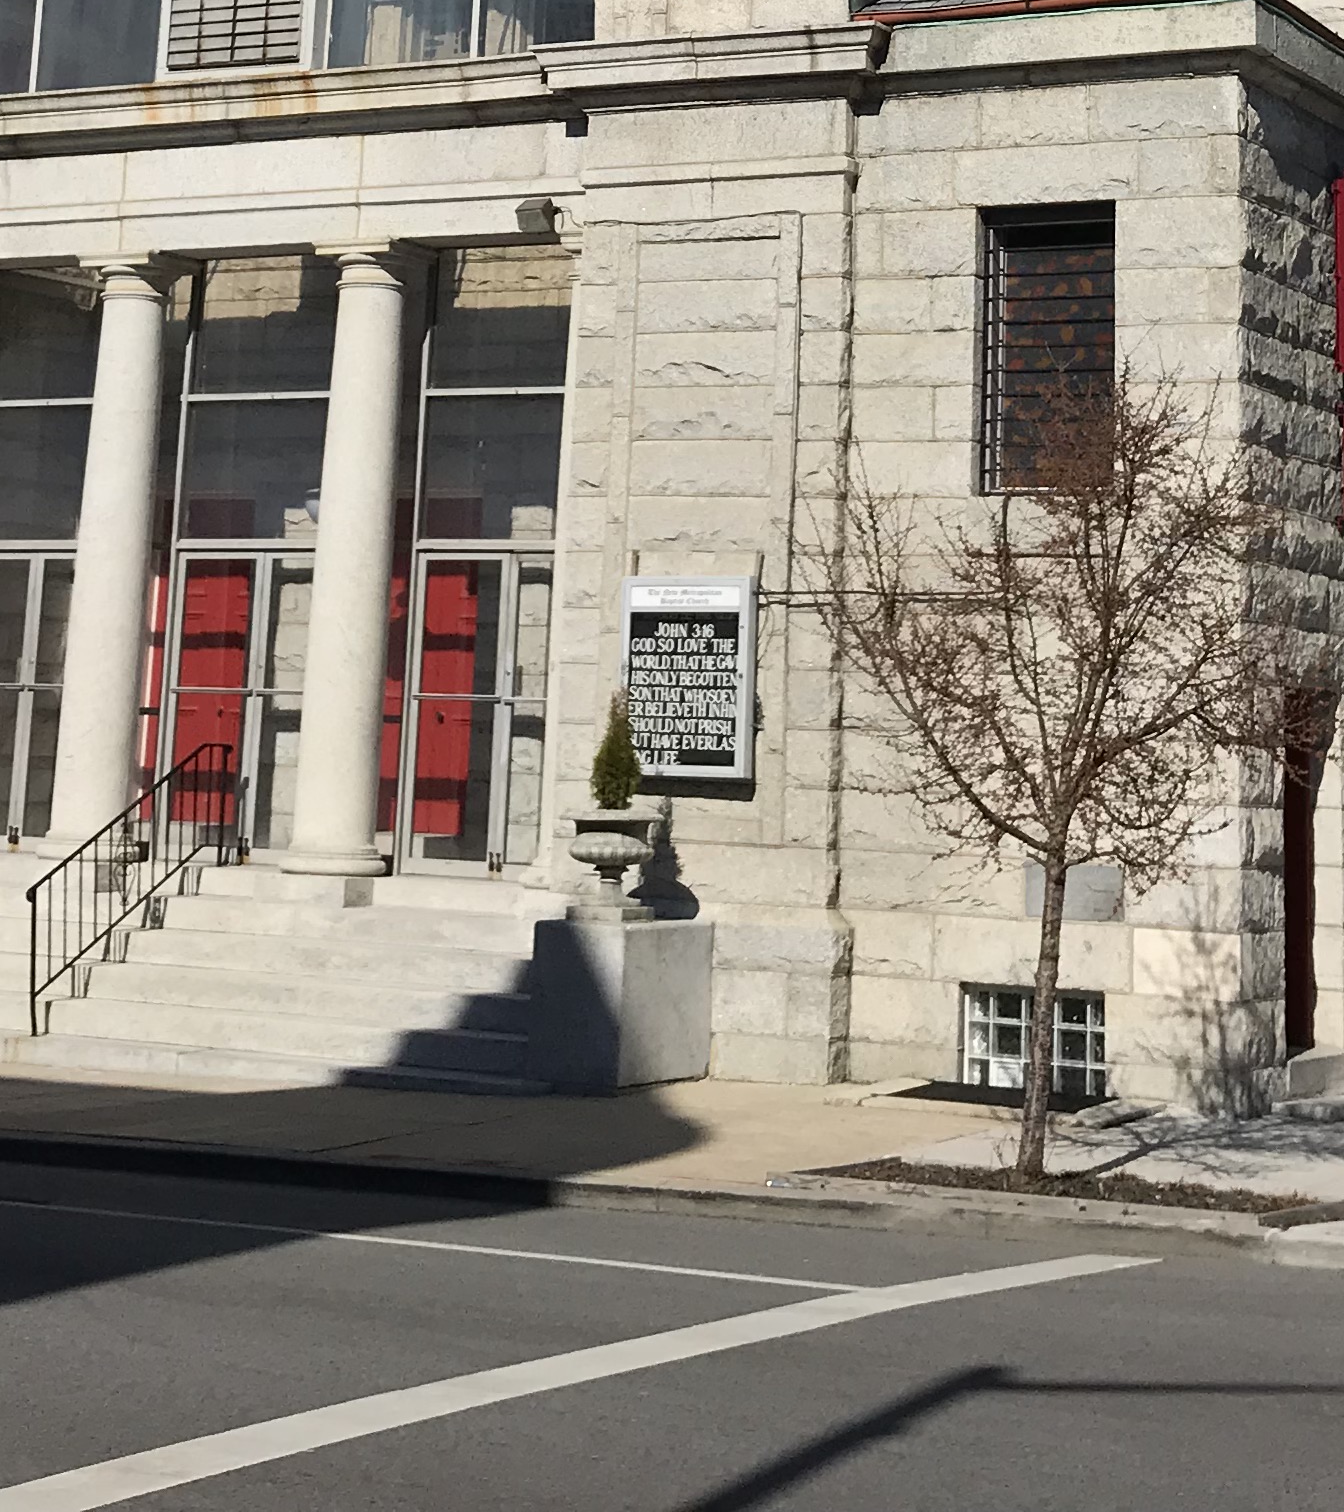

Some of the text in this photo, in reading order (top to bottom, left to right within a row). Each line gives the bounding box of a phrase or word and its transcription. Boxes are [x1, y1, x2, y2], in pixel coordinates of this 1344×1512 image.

[654, 622, 689, 637] JOHN
[631, 638, 736, 654] GOD SO LOVE THE
[671, 655, 701, 670] THAT
[701, 655, 716, 670] HE
[630, 671, 649, 686] HIS
[649, 671, 678, 686] ONLY
[628, 685, 652, 701] SON
[652, 687, 682, 702] THAT
[628, 701, 644, 716] ER
[644, 702, 707, 718] BELIEVETH
[628, 716, 674, 733] SHOULD
[674, 718, 697, 734] NOT
[630, 732, 651, 748] UT
[651, 733, 681, 750] HAVE
